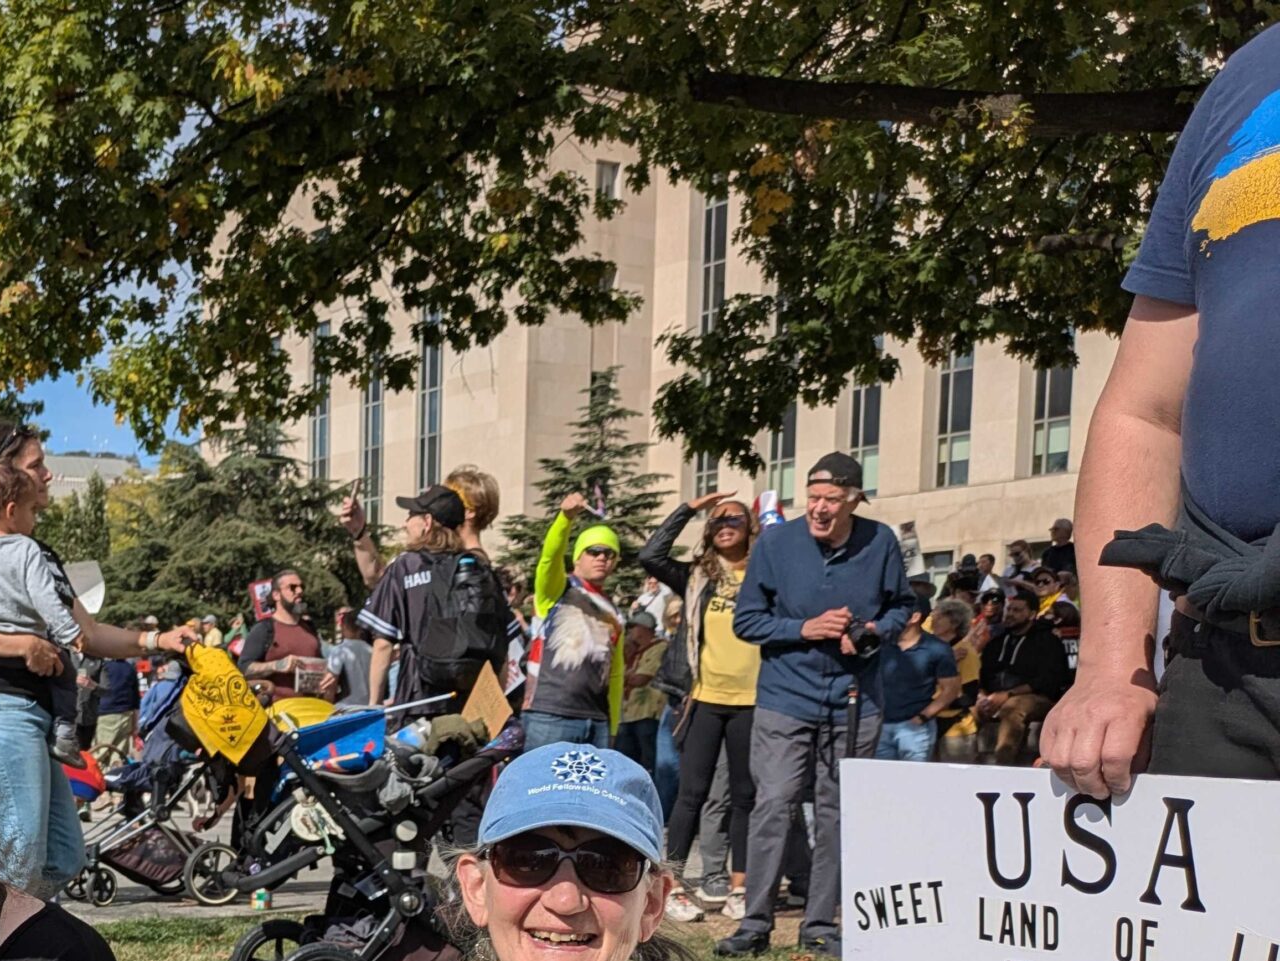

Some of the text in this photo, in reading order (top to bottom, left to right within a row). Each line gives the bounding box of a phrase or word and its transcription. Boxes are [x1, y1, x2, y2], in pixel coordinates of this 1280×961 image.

[528, 783, 551, 796] World
[552, 783, 601, 795] Fellowship
[976, 792, 1206, 912] USA
[854, 880, 945, 931] SWEET
[978, 897, 1059, 950] LAND
